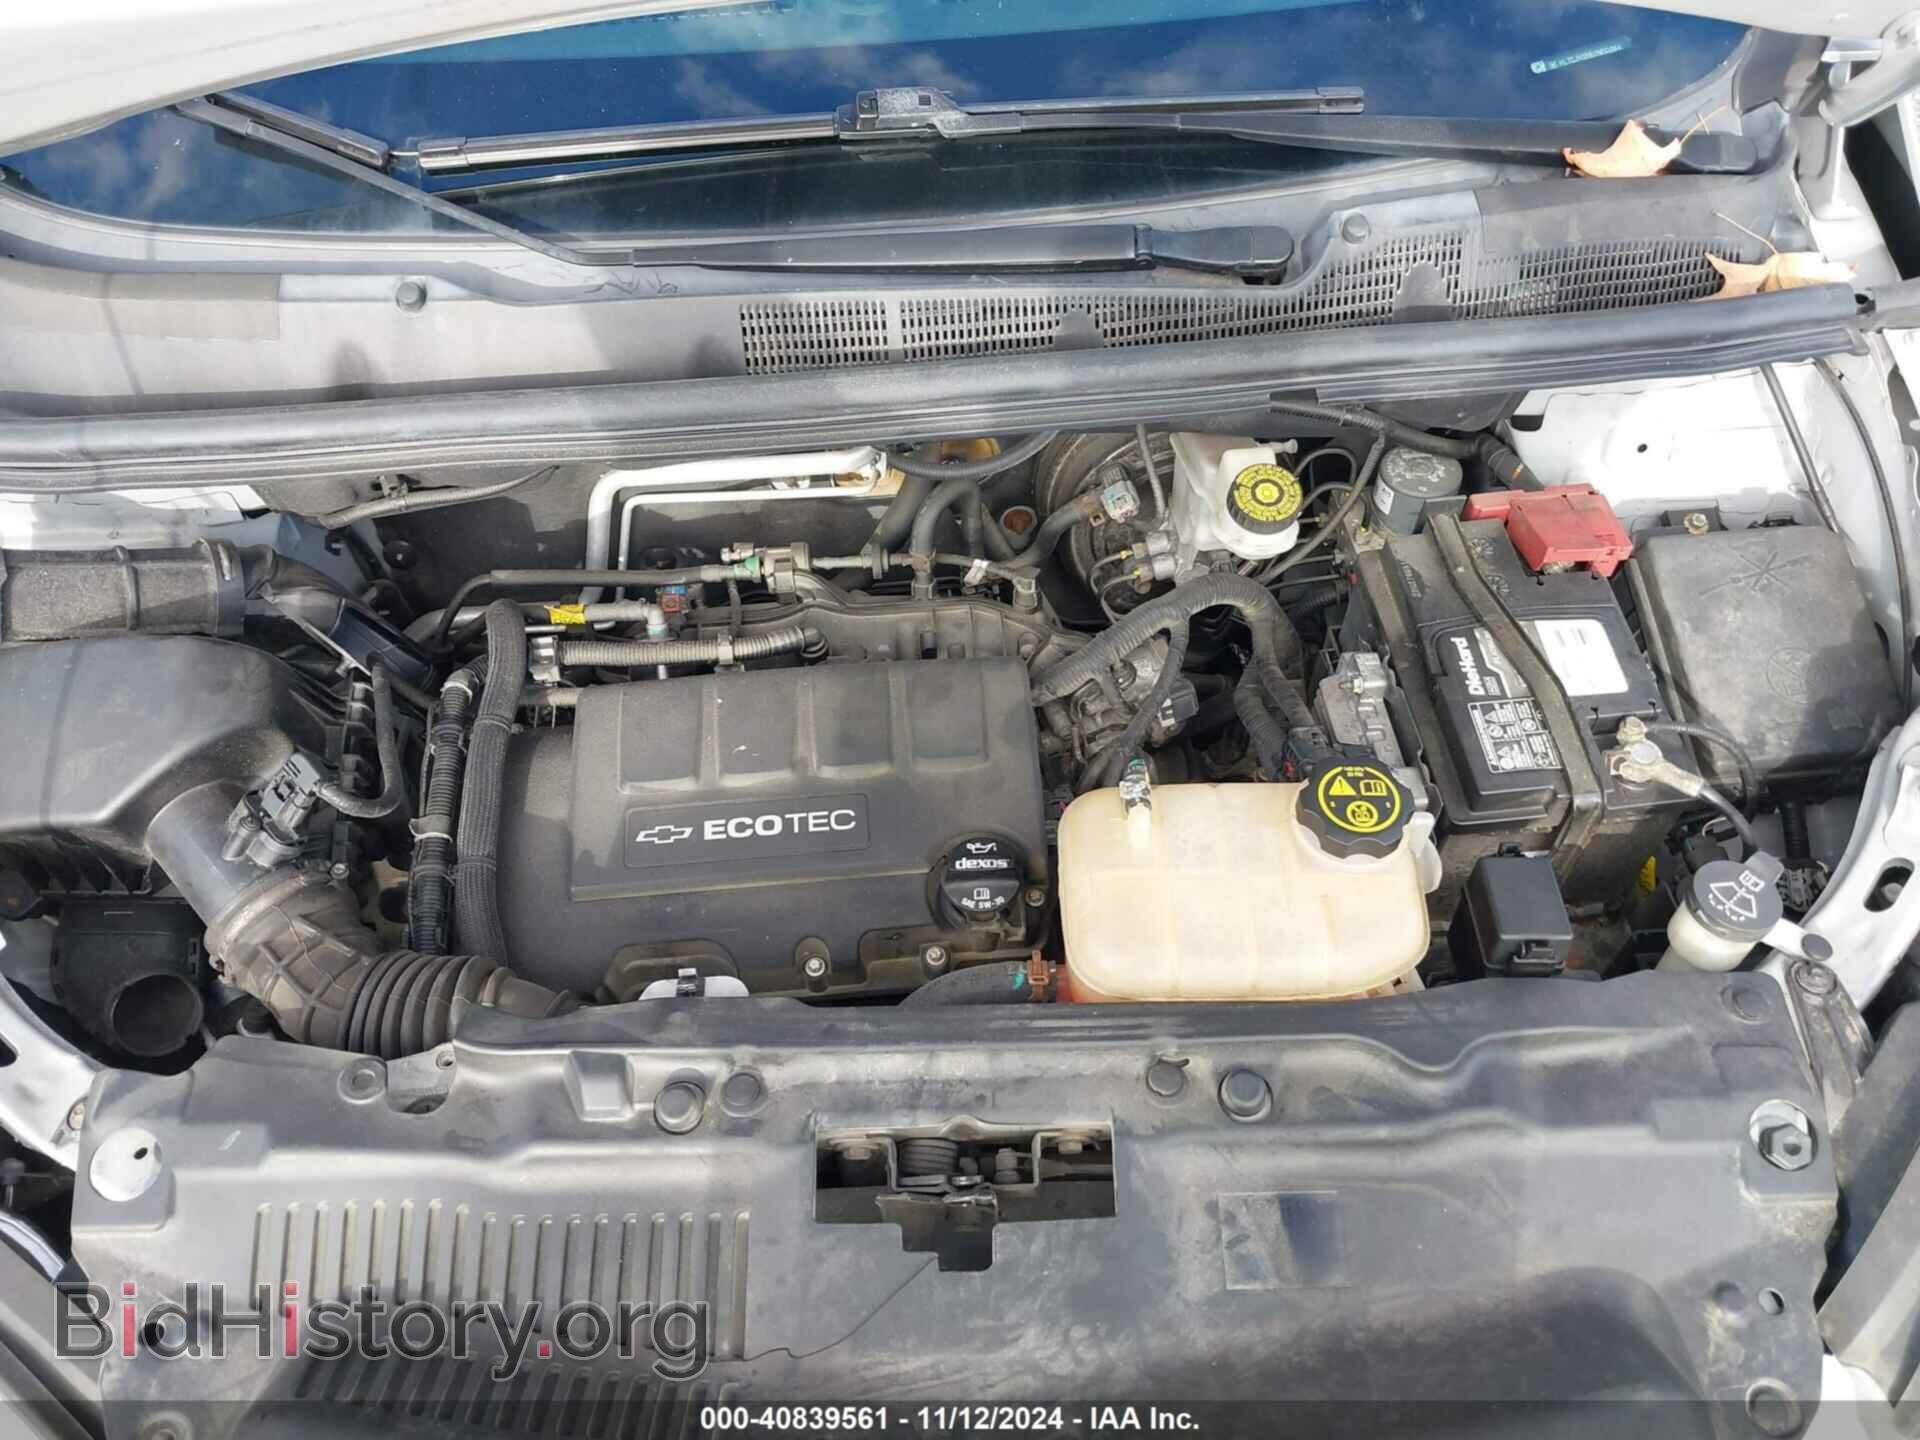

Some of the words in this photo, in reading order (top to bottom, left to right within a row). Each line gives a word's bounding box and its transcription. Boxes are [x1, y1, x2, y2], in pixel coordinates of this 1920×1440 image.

[1450, 637, 1486, 696] DieHard
[703, 809, 856, 840] ECOTEC
[955, 857, 1010, 870] dexos
